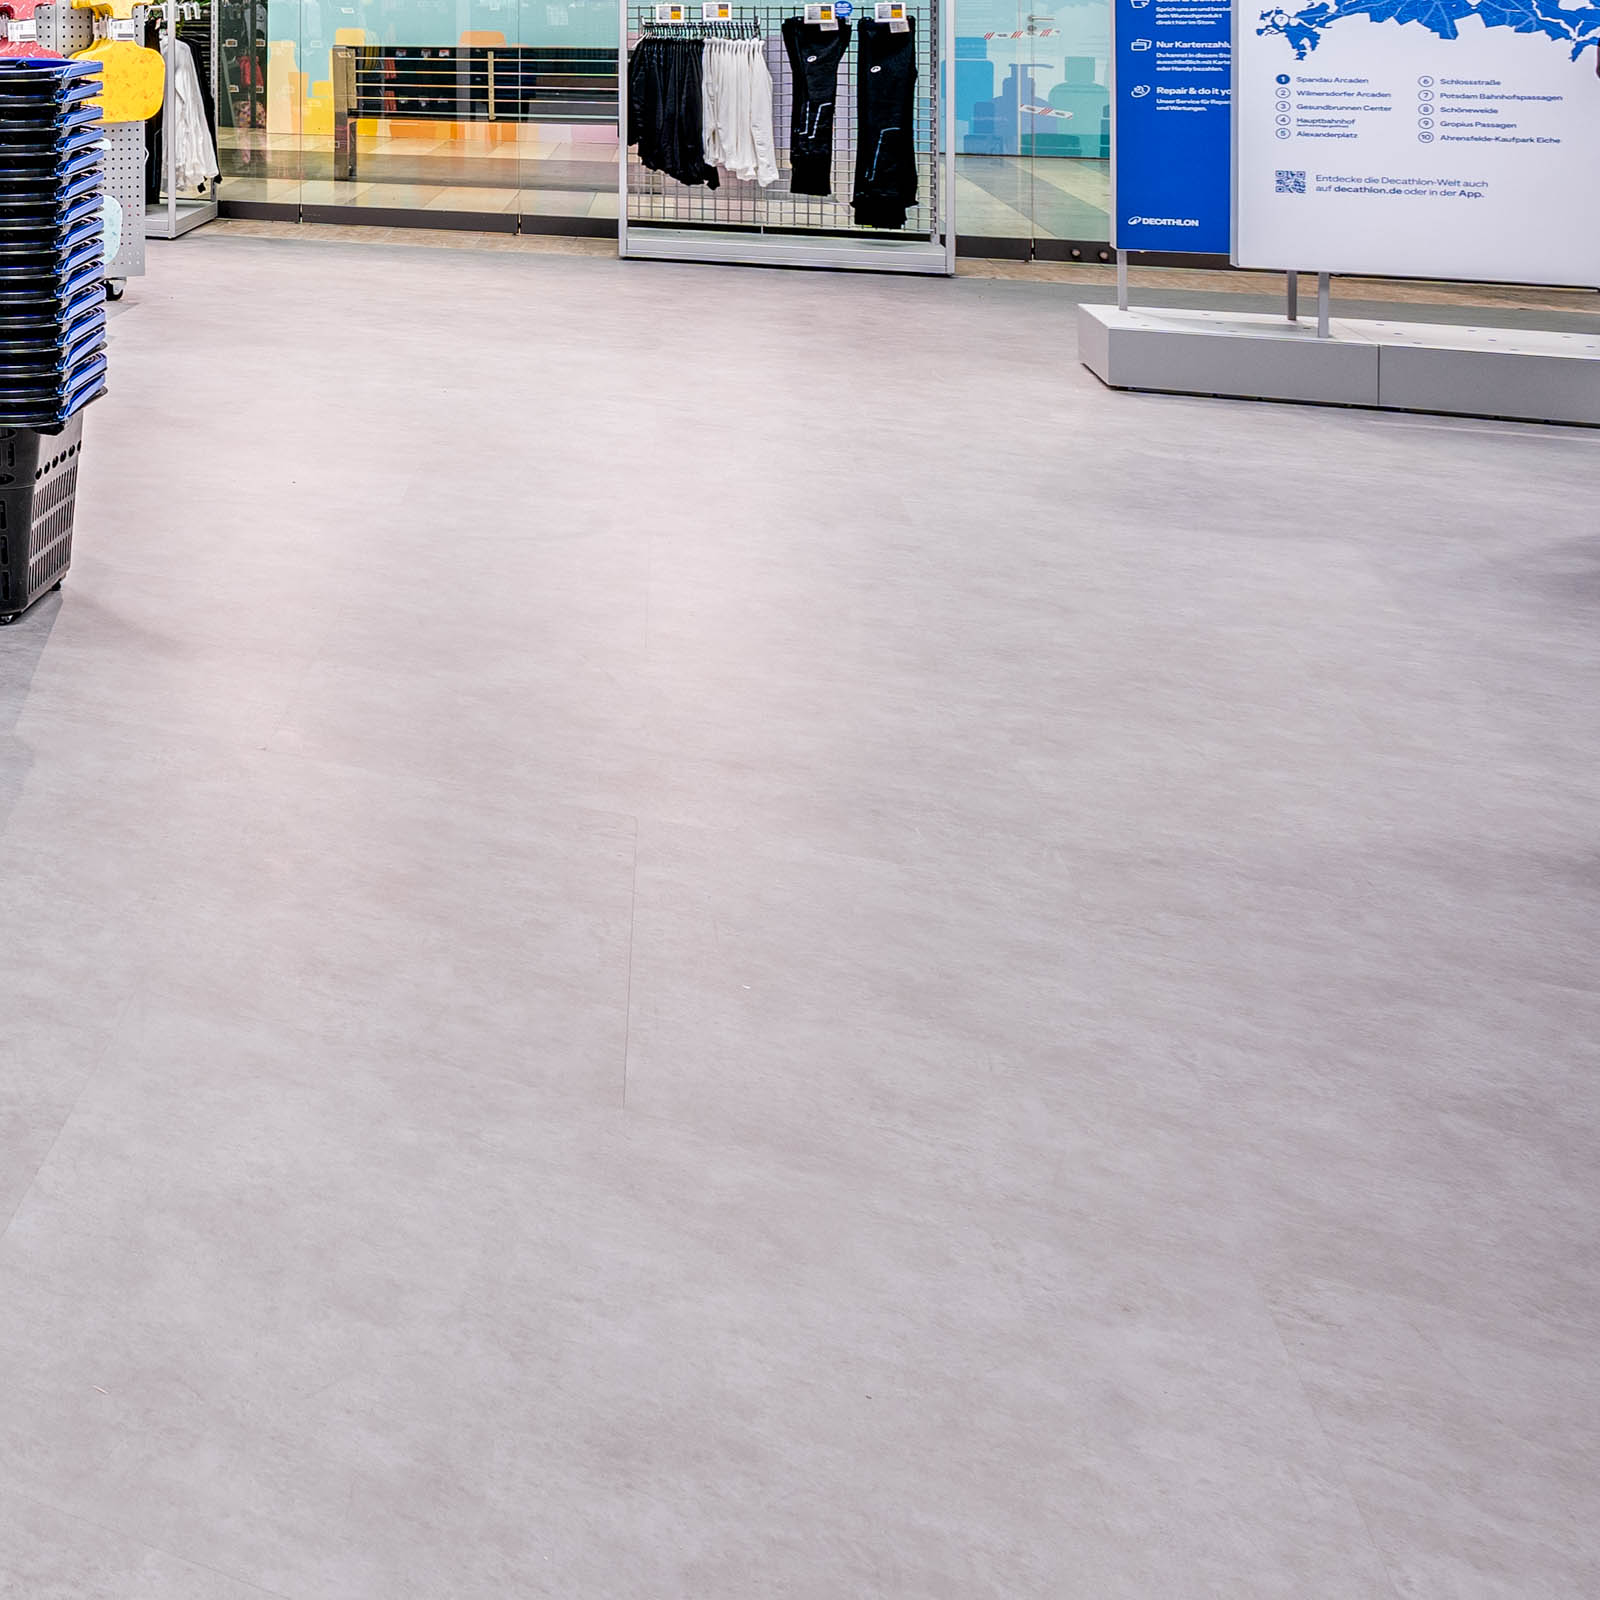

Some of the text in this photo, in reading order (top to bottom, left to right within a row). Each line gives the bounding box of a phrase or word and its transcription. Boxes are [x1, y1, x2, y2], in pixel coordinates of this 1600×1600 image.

[1315, 174, 1489, 189] Entdecke die Decathlon-Welt auch
[1141, 217, 1200, 227] DECATHLON
